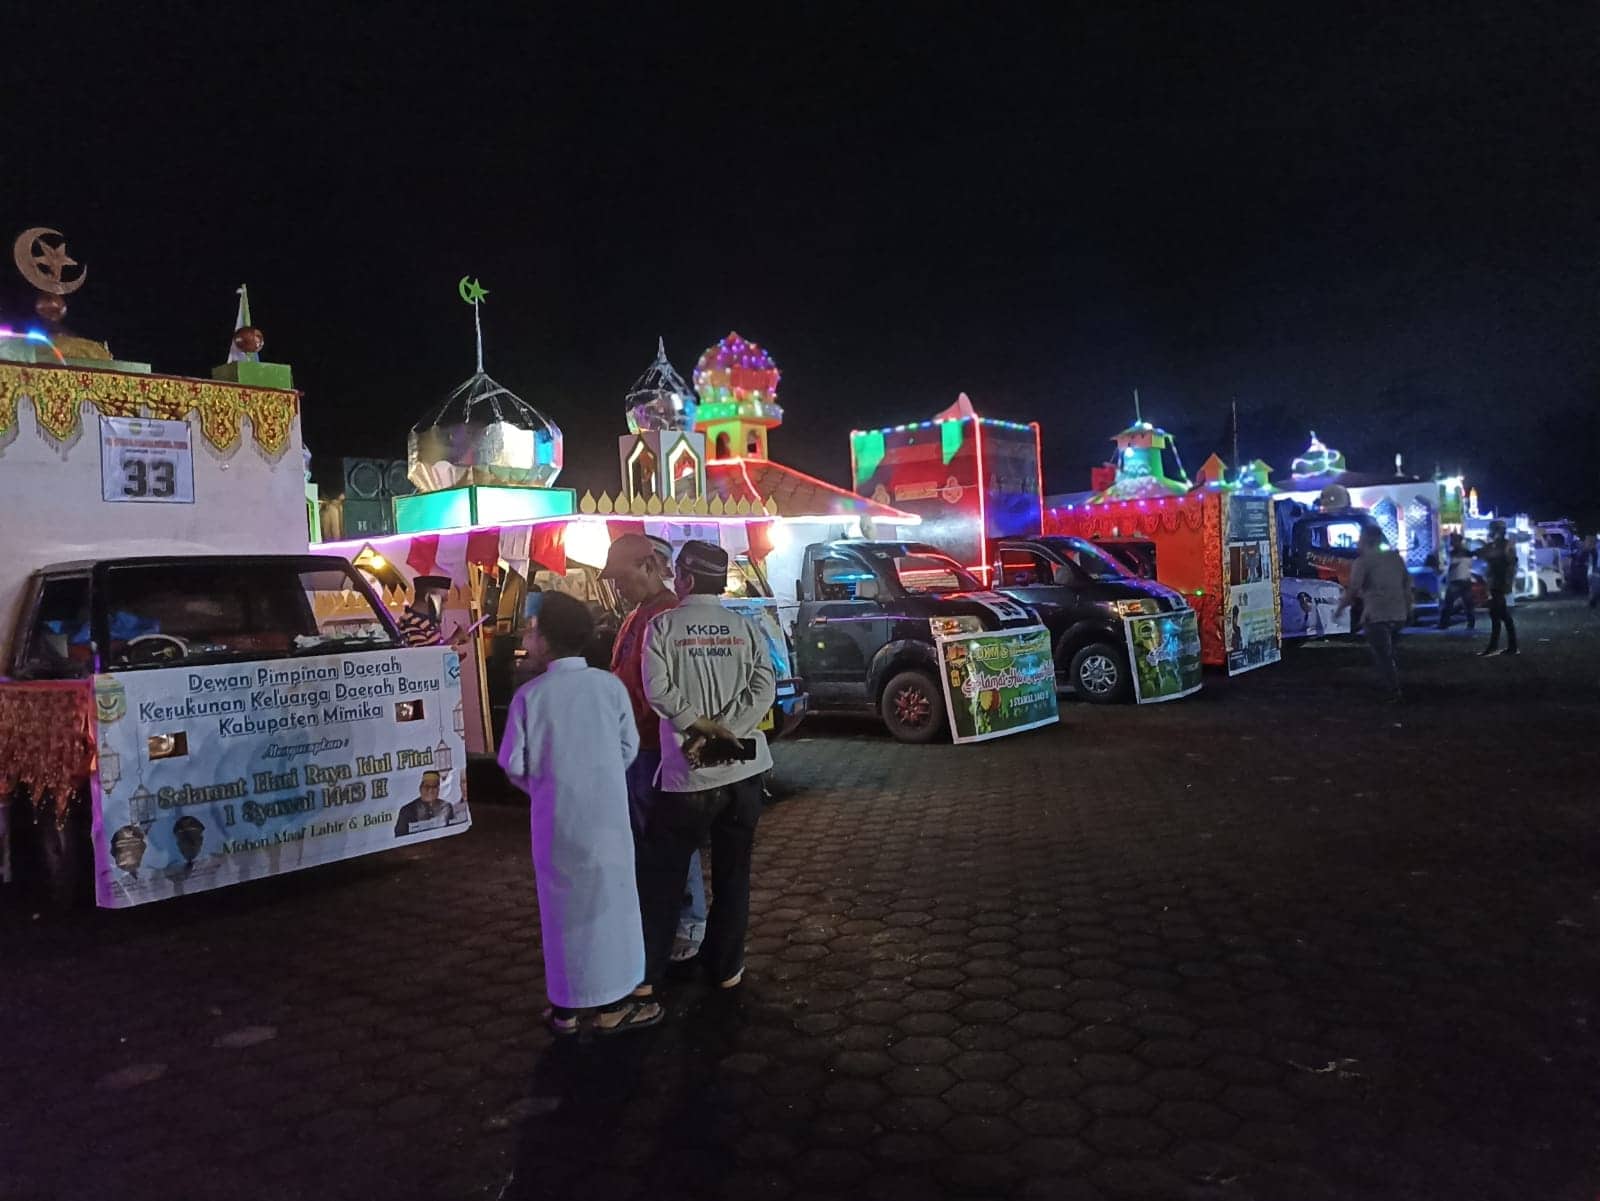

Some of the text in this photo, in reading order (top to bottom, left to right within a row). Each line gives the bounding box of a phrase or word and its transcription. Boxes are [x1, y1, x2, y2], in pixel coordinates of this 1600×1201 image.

[123, 460, 175, 497] 33
[686, 624, 730, 635] KKDB
[188, 655, 402, 693] Dewan Pimpinan Daerah
[139, 676, 440, 722] Kerukunan Keluarga Daerah Barru
[219, 701, 384, 738] Kabupaten Mimika
[158, 746, 433, 809] Selamat Hari Raya Idul Fitri
[242, 791, 315, 827] Syawal
[322, 781, 367, 809] 1443
[371, 777, 389, 800] H
[222, 836, 270, 855] Mohon
[274, 826, 307, 845] Maaf
[311, 820, 344, 838] Lahir
[363, 811, 393, 829] Batin
